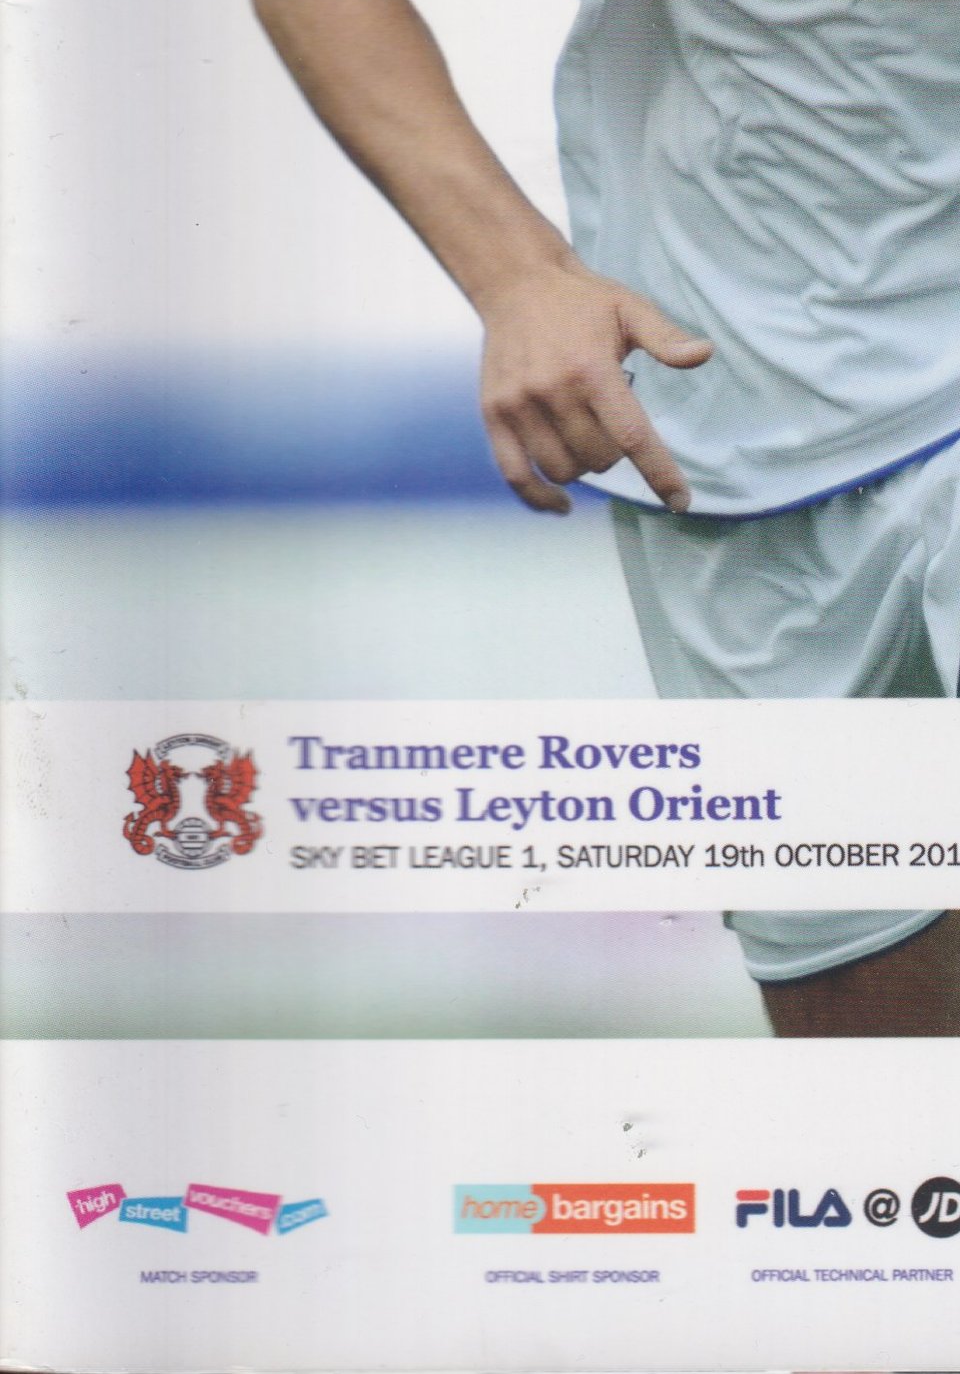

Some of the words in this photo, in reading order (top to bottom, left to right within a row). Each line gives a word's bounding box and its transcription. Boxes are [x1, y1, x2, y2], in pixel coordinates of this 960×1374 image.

[289, 736, 526, 770] Tranmere
[538, 735, 701, 769] Rovers
[289, 791, 442, 822] versus
[456, 788, 614, 832] Leyton
[628, 785, 782, 821] Orient
[290, 845, 343, 870] SKY
[351, 845, 400, 870] BET
[409, 845, 512, 869] LEAGUE
[522, 845, 547, 873] 1,
[557, 844, 694, 869] SATURDAY
[705, 844, 764, 868] 19th
[775, 843, 900, 868] OCTOBER
[75, 1190, 116, 1215] high
[125, 1203, 181, 1223] street
[188, 1191, 274, 1221] vouchers
[460, 1196, 538, 1219] home
[552, 1193, 688, 1226] bargains
[736, 1188, 853, 1228] FILA
[140, 1270, 187, 1283] MATCH
[191, 1270, 259, 1283] SPONSOR
[484, 1270, 546, 1283] OFFICIAL
[548, 1270, 589, 1283] SHIRT
[592, 1270, 661, 1283] SPONSOR
[751, 1269, 811, 1282] OFFICIAL
[814, 1269, 888, 1282] TECHNICAL
[892, 1269, 954, 1282] PARTNER
